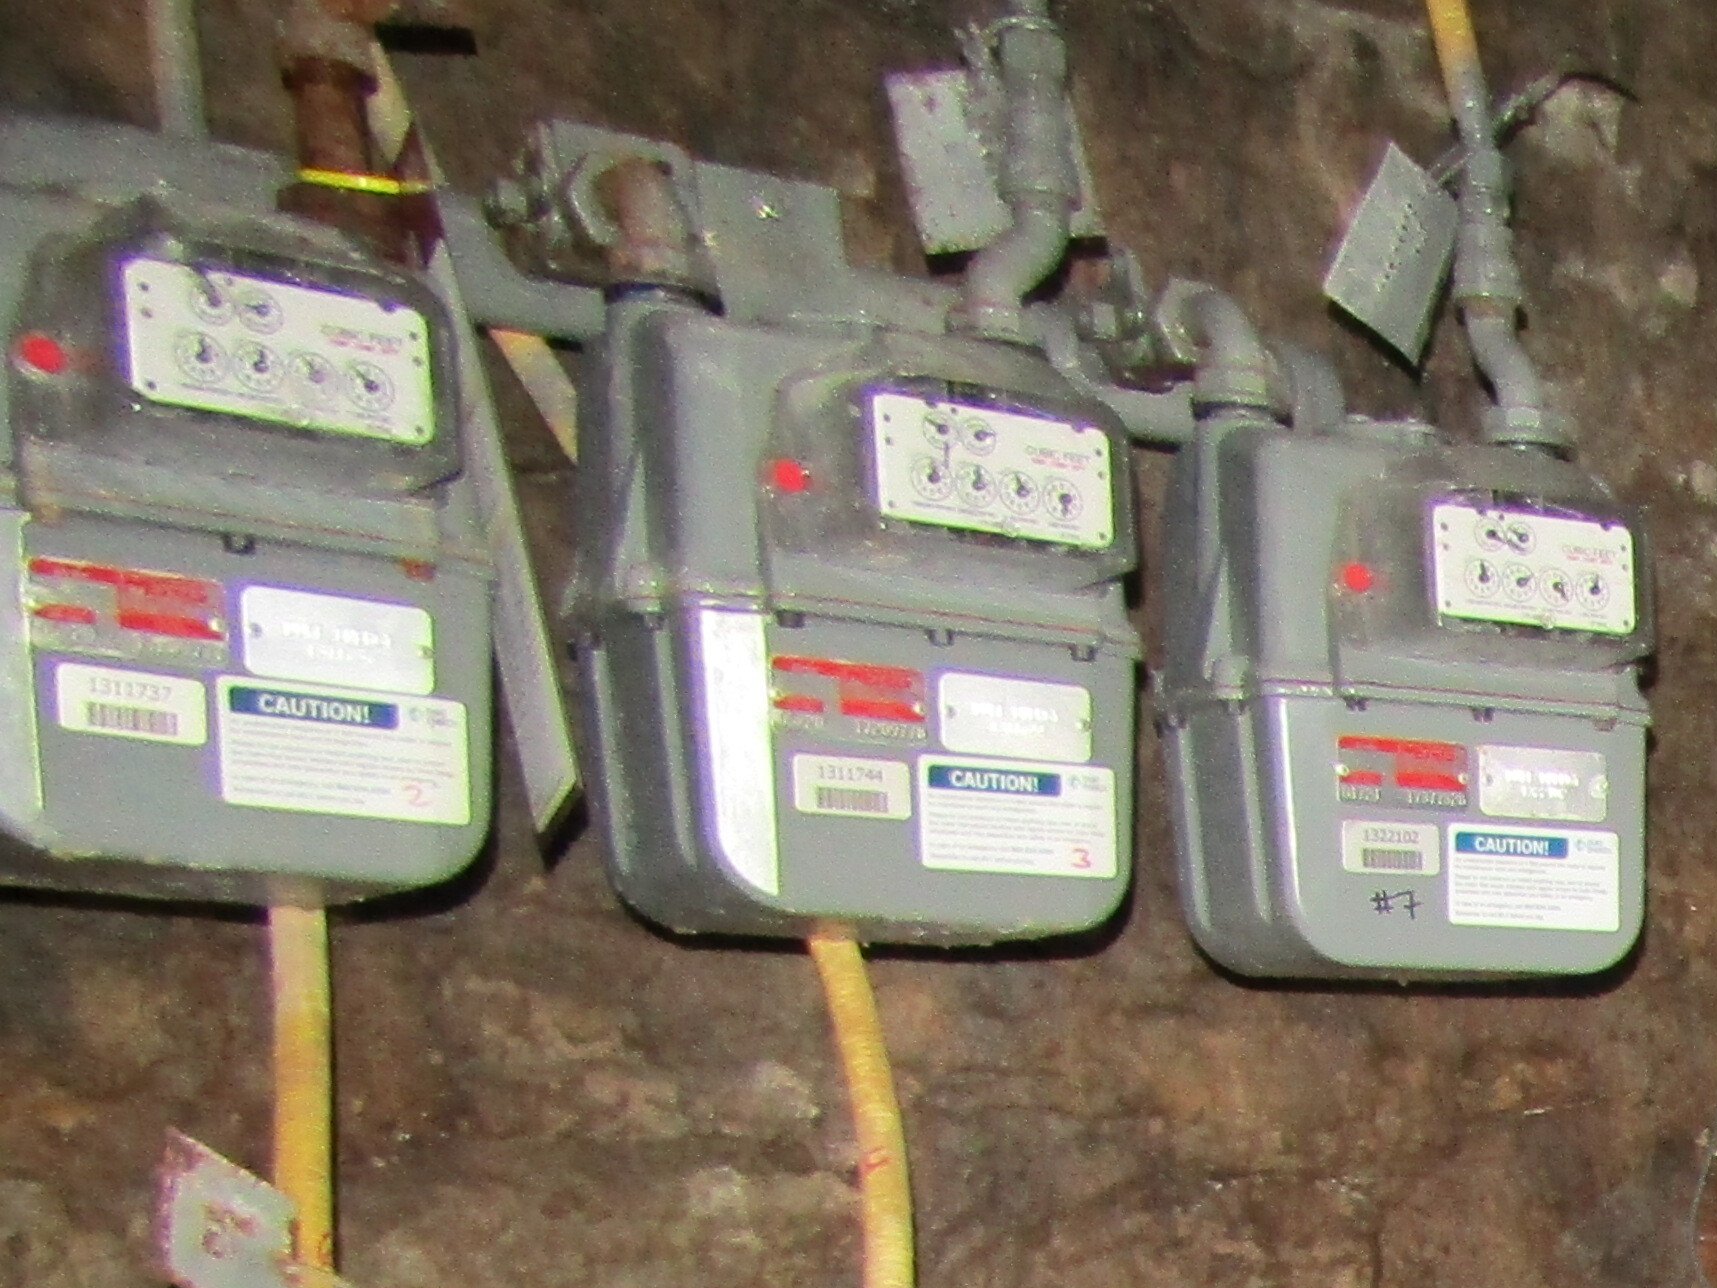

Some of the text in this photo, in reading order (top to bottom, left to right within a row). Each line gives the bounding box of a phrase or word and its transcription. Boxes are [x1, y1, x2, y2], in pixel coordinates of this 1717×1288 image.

[258, 693, 370, 724] CAUTION!
[949, 770, 1039, 793] CAUTION!
[1474, 837, 1550, 856] CAUTION!
[1071, 847, 1093, 869] 3
